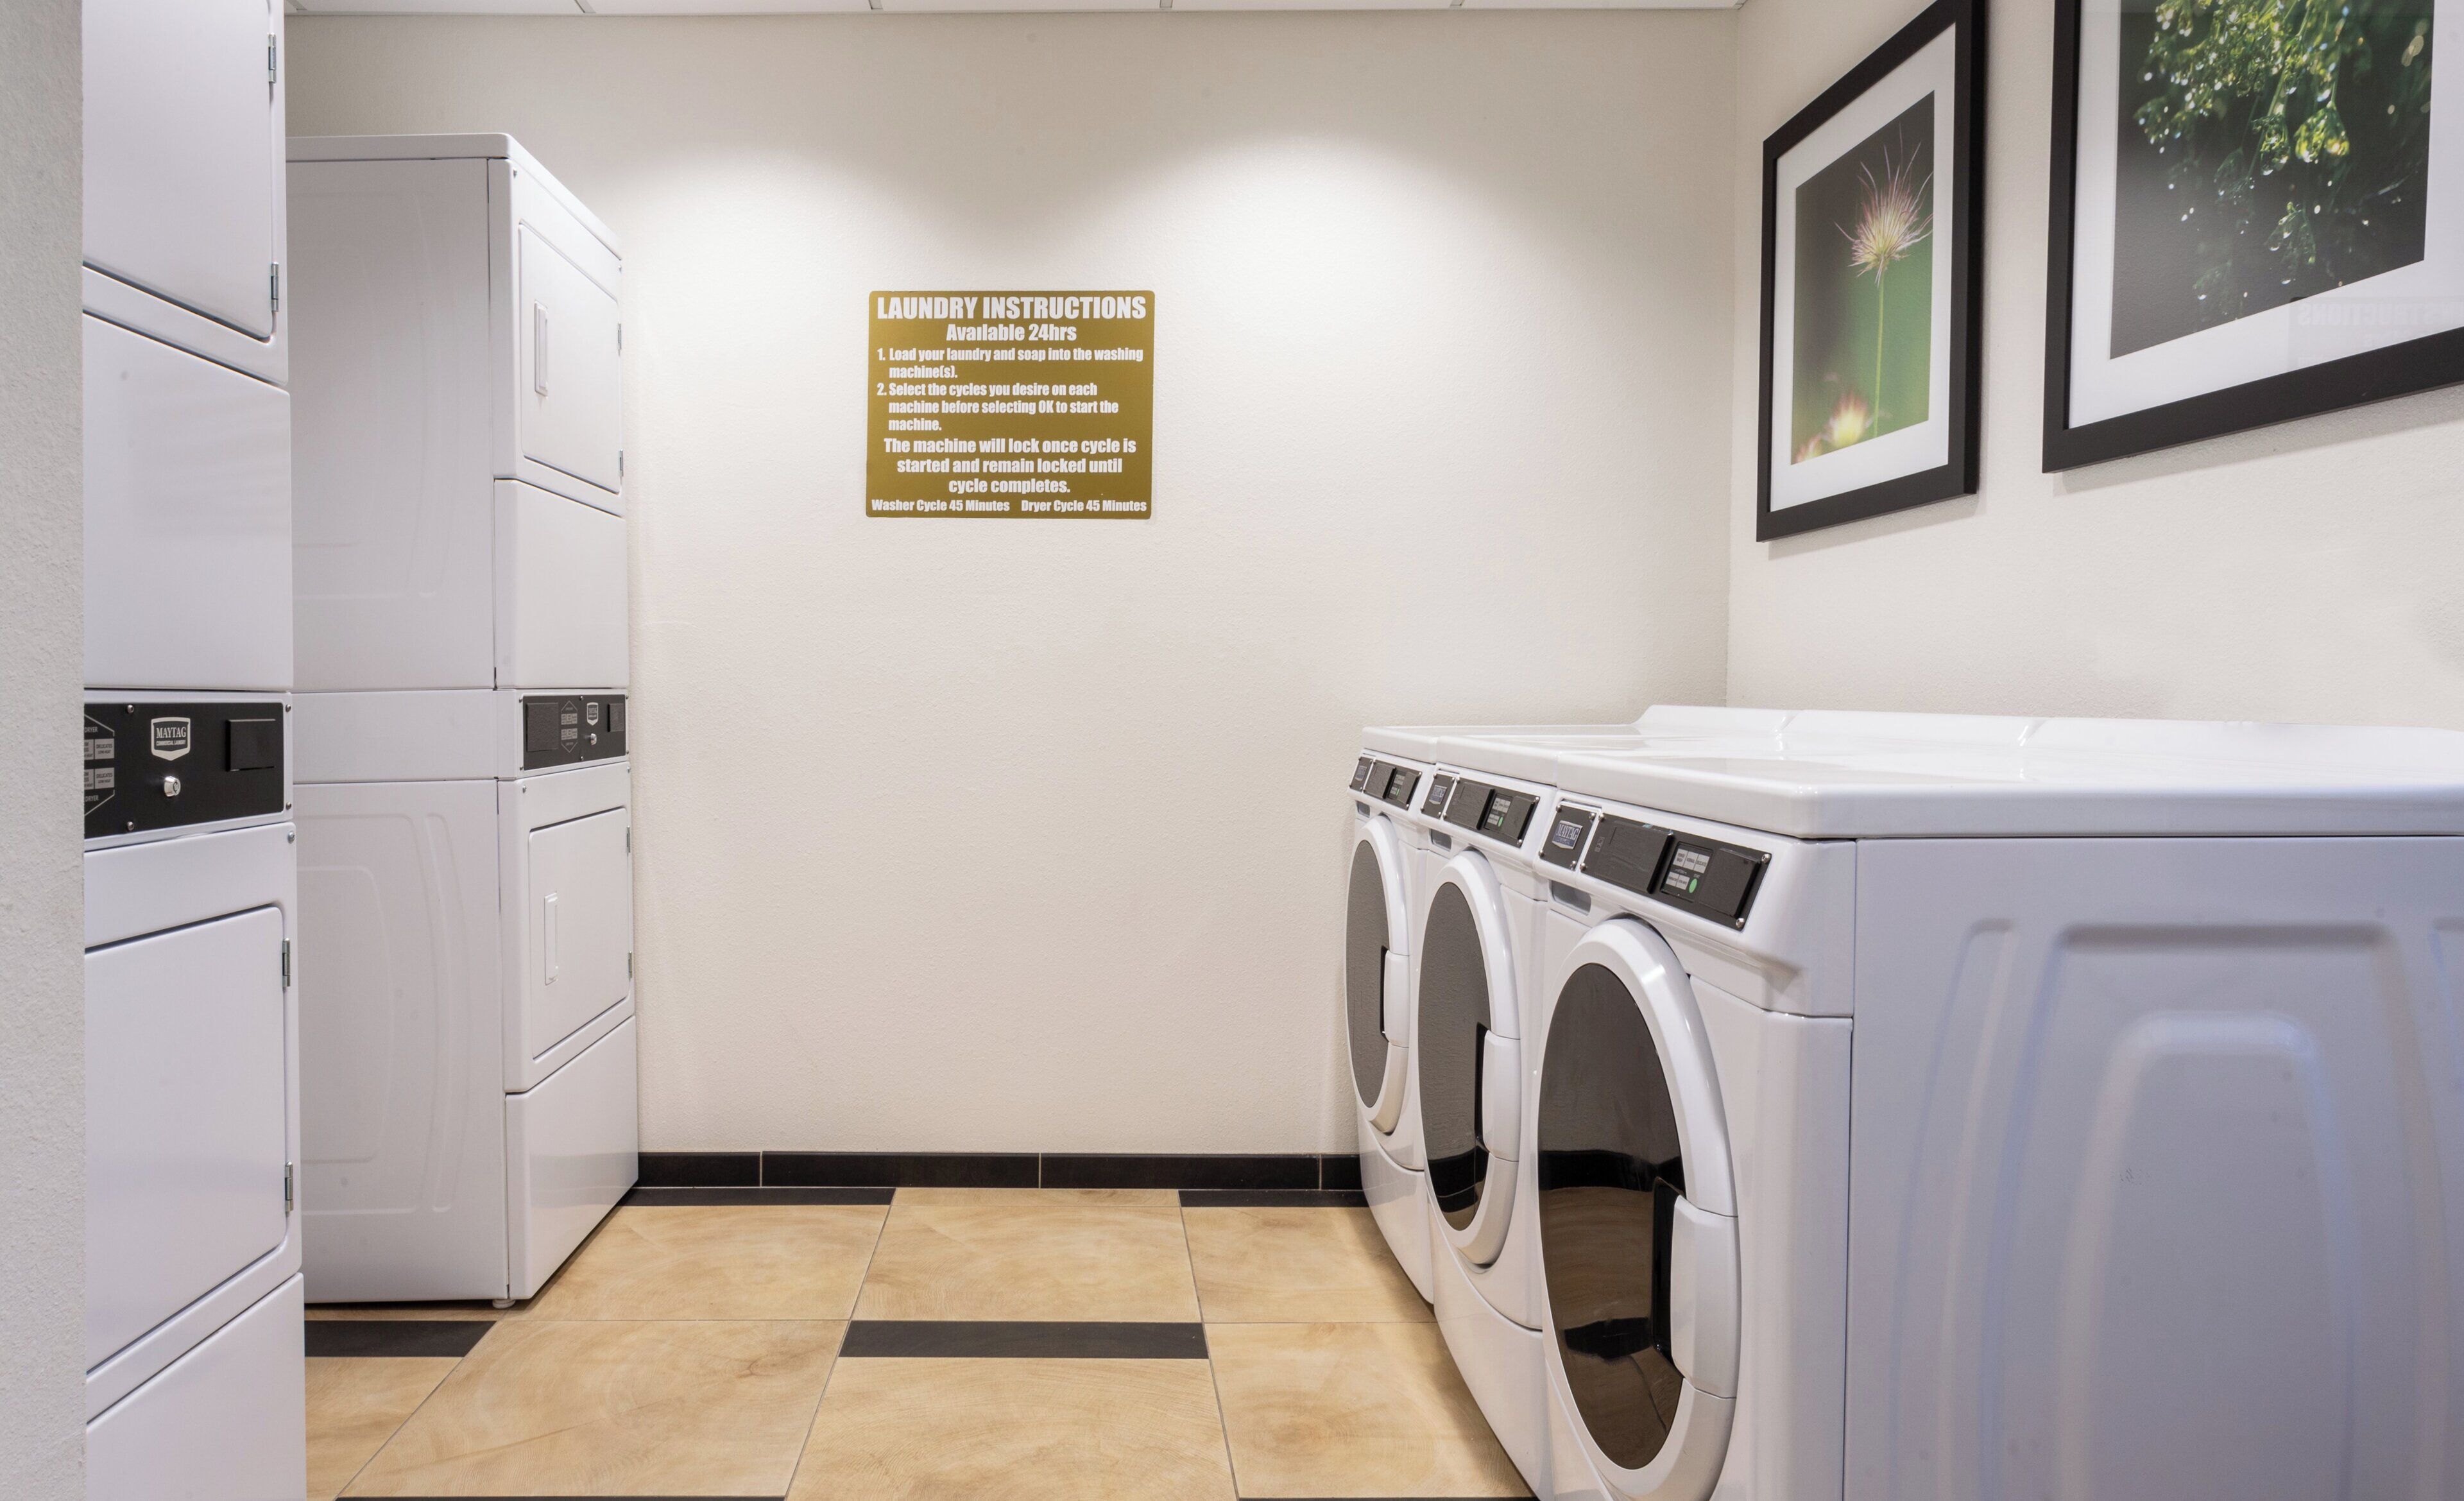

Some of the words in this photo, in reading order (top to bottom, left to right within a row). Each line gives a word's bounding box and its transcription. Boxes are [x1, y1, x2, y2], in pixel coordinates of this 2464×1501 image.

[877, 296, 979, 320] LAUNDRY
[982, 295, 1147, 320] INSTRUCTIONS
[946, 323, 1025, 341] Available
[1028, 323, 1077, 341] 24hrs
[877, 347, 886, 361] 1.
[889, 347, 917, 361] Load
[918, 349, 945, 363] your
[946, 347, 992, 362] laundry
[993, 347, 1016, 361] and
[1017, 349, 1047, 362] soap
[1048, 347, 1072, 361] into
[1072, 347, 1093, 361] the
[1093, 347, 1143, 363] washing
[889, 365, 958, 379] machine(s).
[877, 382, 887, 396] 2.
[888, 382, 927, 397] Select
[927, 382, 947, 396] the
[948, 382, 988, 397] cycles
[989, 384, 1011, 397] you
[1012, 382, 1050, 396] desire
[1051, 384, 1067, 396] on
[1068, 382, 1098, 396] each
[888, 400, 940, 414] machine
[941, 400, 980, 414] before
[981, 400, 1036, 415] selecting
[1038, 400, 1054, 414] OK
[1055, 400, 1068, 414] to
[1069, 400, 1099, 414] start
[1099, 400, 1119, 414] the
[888, 417, 942, 431] machine.
[883, 437, 911, 453] The
[912, 438, 977, 453] machine
[979, 438, 1005, 453] will
[1008, 438, 1040, 453] lock
[1041, 440, 1079, 453] once
[1081, 438, 1120, 454] cycle
[1123, 438, 1136, 453] is
[896, 458, 950, 473] started
[952, 458, 980, 473] and
[982, 458, 1034, 473] remain
[1037, 458, 1086, 473] locked
[1089, 458, 1123, 473] until
[948, 477, 988, 494] cycle
[990, 478, 1071, 495] completes.
[871, 499, 915, 511] Washer
[916, 499, 948, 512] Cycle
[948, 499, 964, 511] 45
[965, 499, 1010, 511] Minutes
[1021, 499, 1052, 513] Dryer
[1053, 499, 1084, 513] Cycle
[1086, 499, 1100, 511] 45
[1102, 499, 1147, 511] Minutes
[156, 726, 186, 738] MAYTAG
[1555, 824, 1579, 841] MAYTAG
